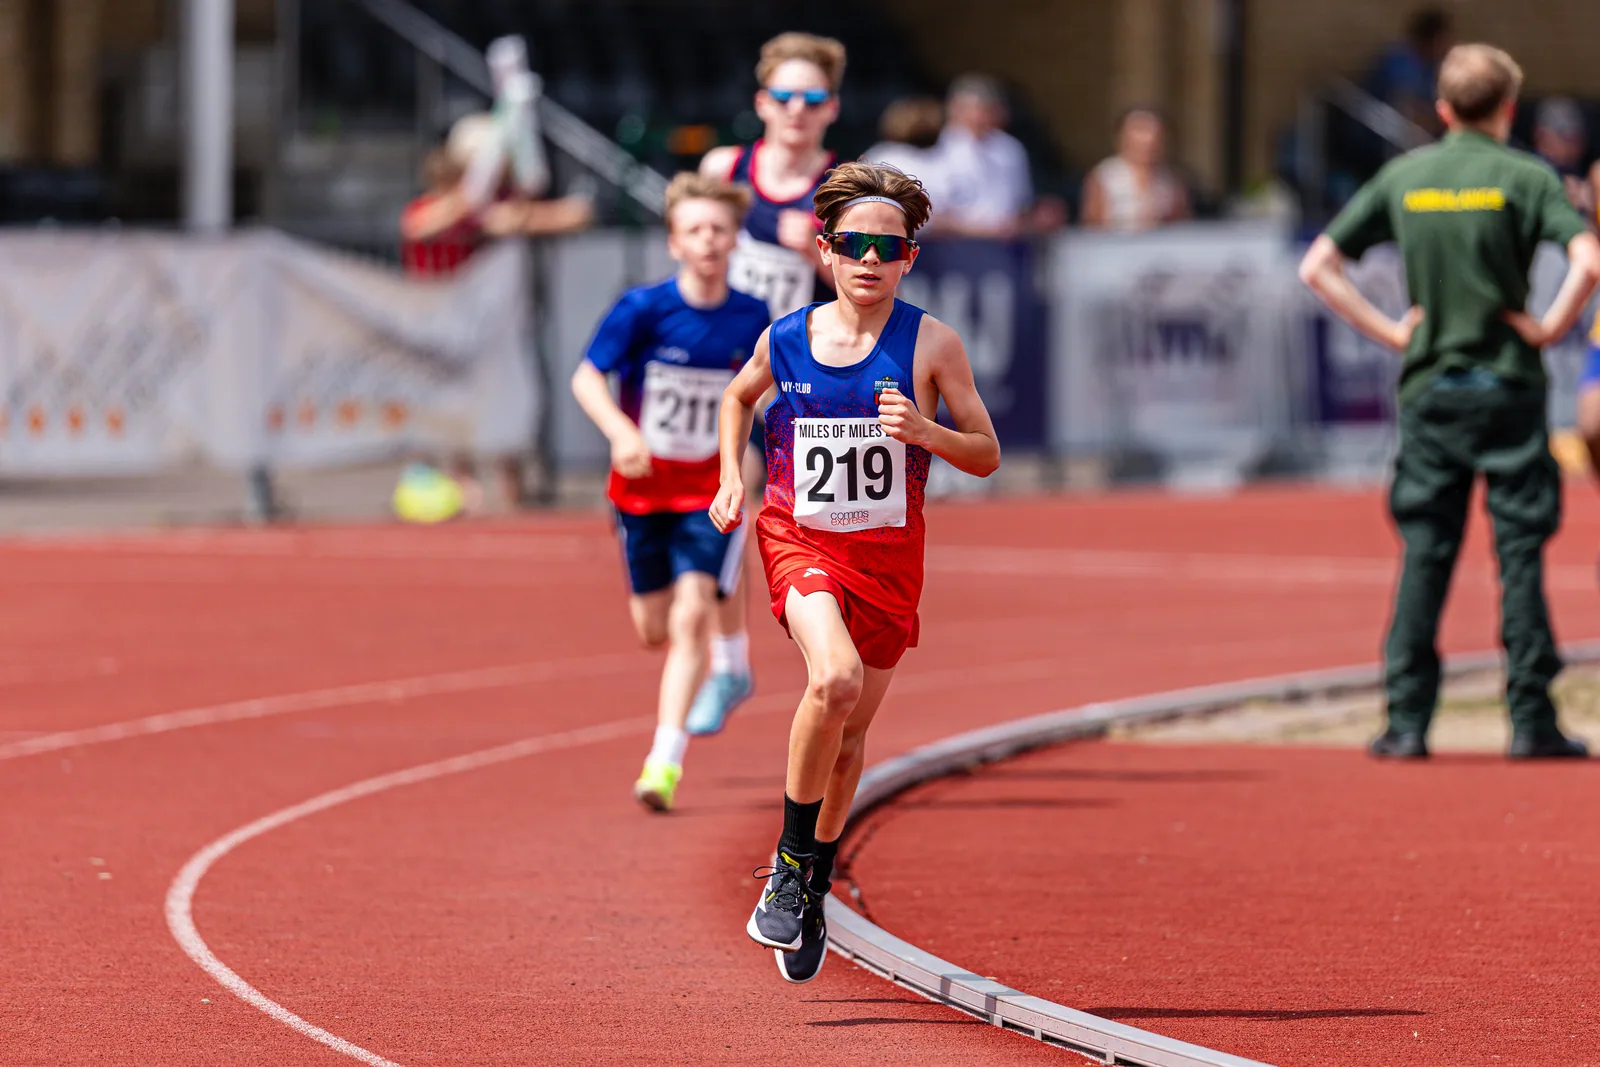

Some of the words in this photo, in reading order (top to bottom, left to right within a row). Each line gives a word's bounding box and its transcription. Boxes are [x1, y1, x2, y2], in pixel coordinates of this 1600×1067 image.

[658, 388, 718, 436] 211
[799, 424, 830, 438] MILES
[832, 424, 846, 438] OF
[848, 423, 882, 438] MILES
[805, 446, 893, 502] 219
[830, 510, 869, 519] comms
[831, 516, 869, 526] express
